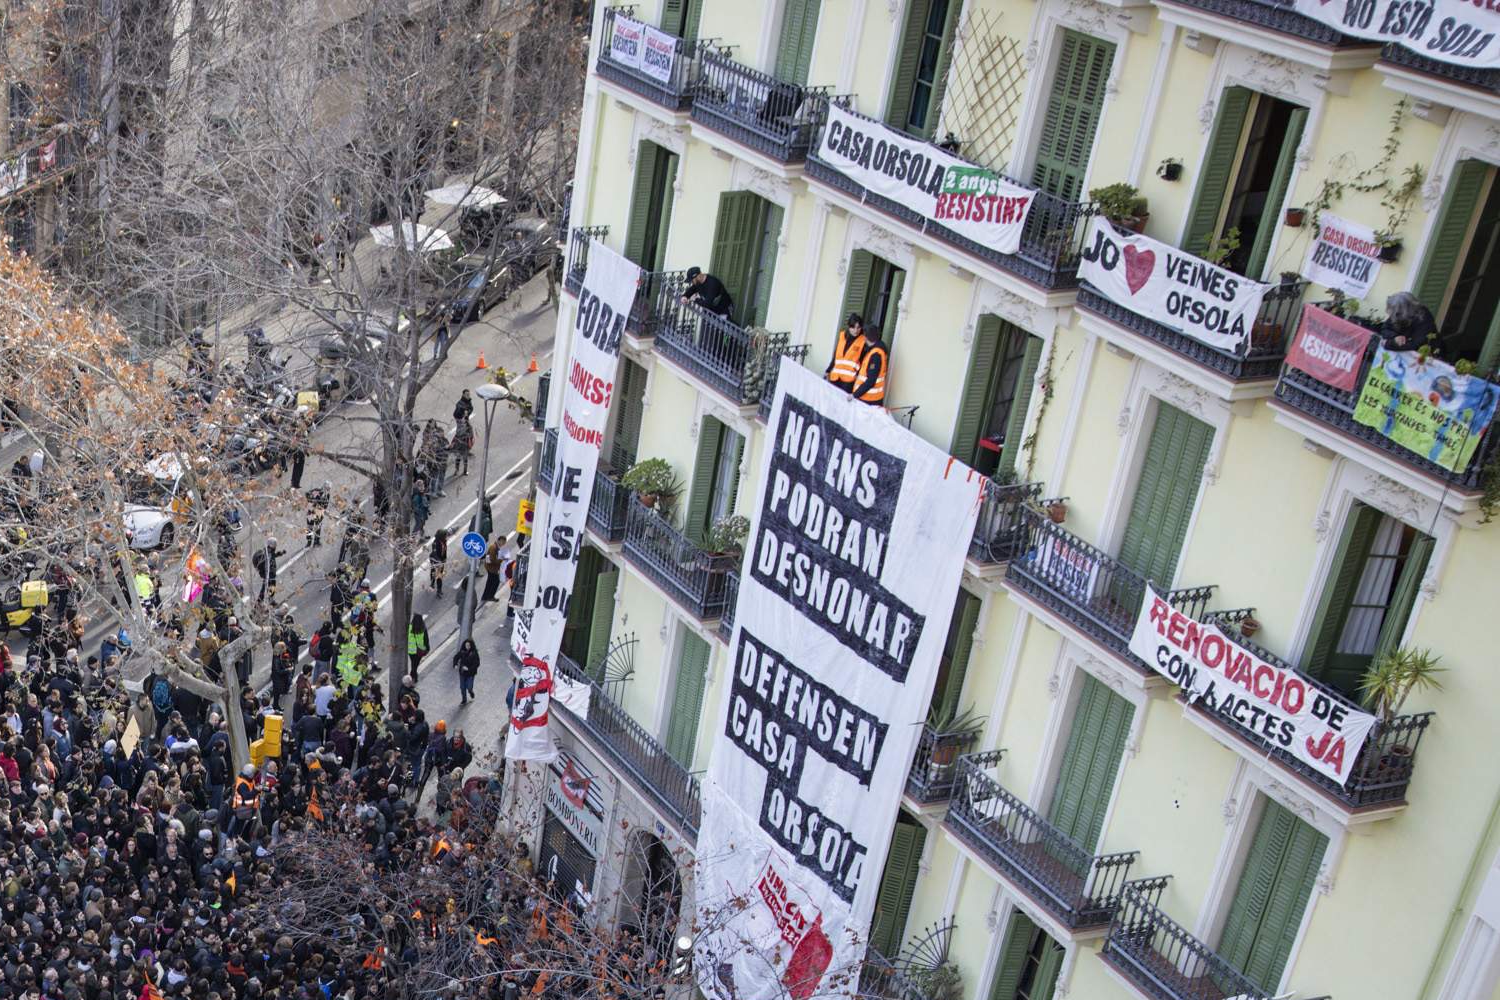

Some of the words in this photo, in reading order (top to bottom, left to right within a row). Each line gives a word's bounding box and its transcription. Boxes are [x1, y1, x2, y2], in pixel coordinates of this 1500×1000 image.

[1342, 0, 1376, 29] NO
[1426, 16, 1496, 59] SOLA
[934, 192, 1030, 225] RESISTINT
[946, 171, 957, 190] 2
[958, 171, 998, 198] anys
[1083, 229, 1121, 271] JO
[1166, 253, 1239, 302] VEÏNES
[1311, 242, 1374, 283] RESISTEIX
[1322, 226, 1346, 246] CASA
[576, 287, 626, 360] FORA
[1363, 394, 1379, 408] LES
[1368, 377, 1380, 388] EL
[782, 411, 821, 472] NO
[824, 438, 879, 509] ENS
[770, 469, 886, 580] PODRAN
[757, 530, 912, 665] DESNONAR
[739, 637, 877, 772] DEFENSEN
[1310, 693, 1349, 732] DE
[731, 694, 798, 778] CASA
[1305, 729, 1346, 776] JA
[548, 788, 598, 853] BOMBONERIA
[767, 787, 867, 892] ORSOLA
